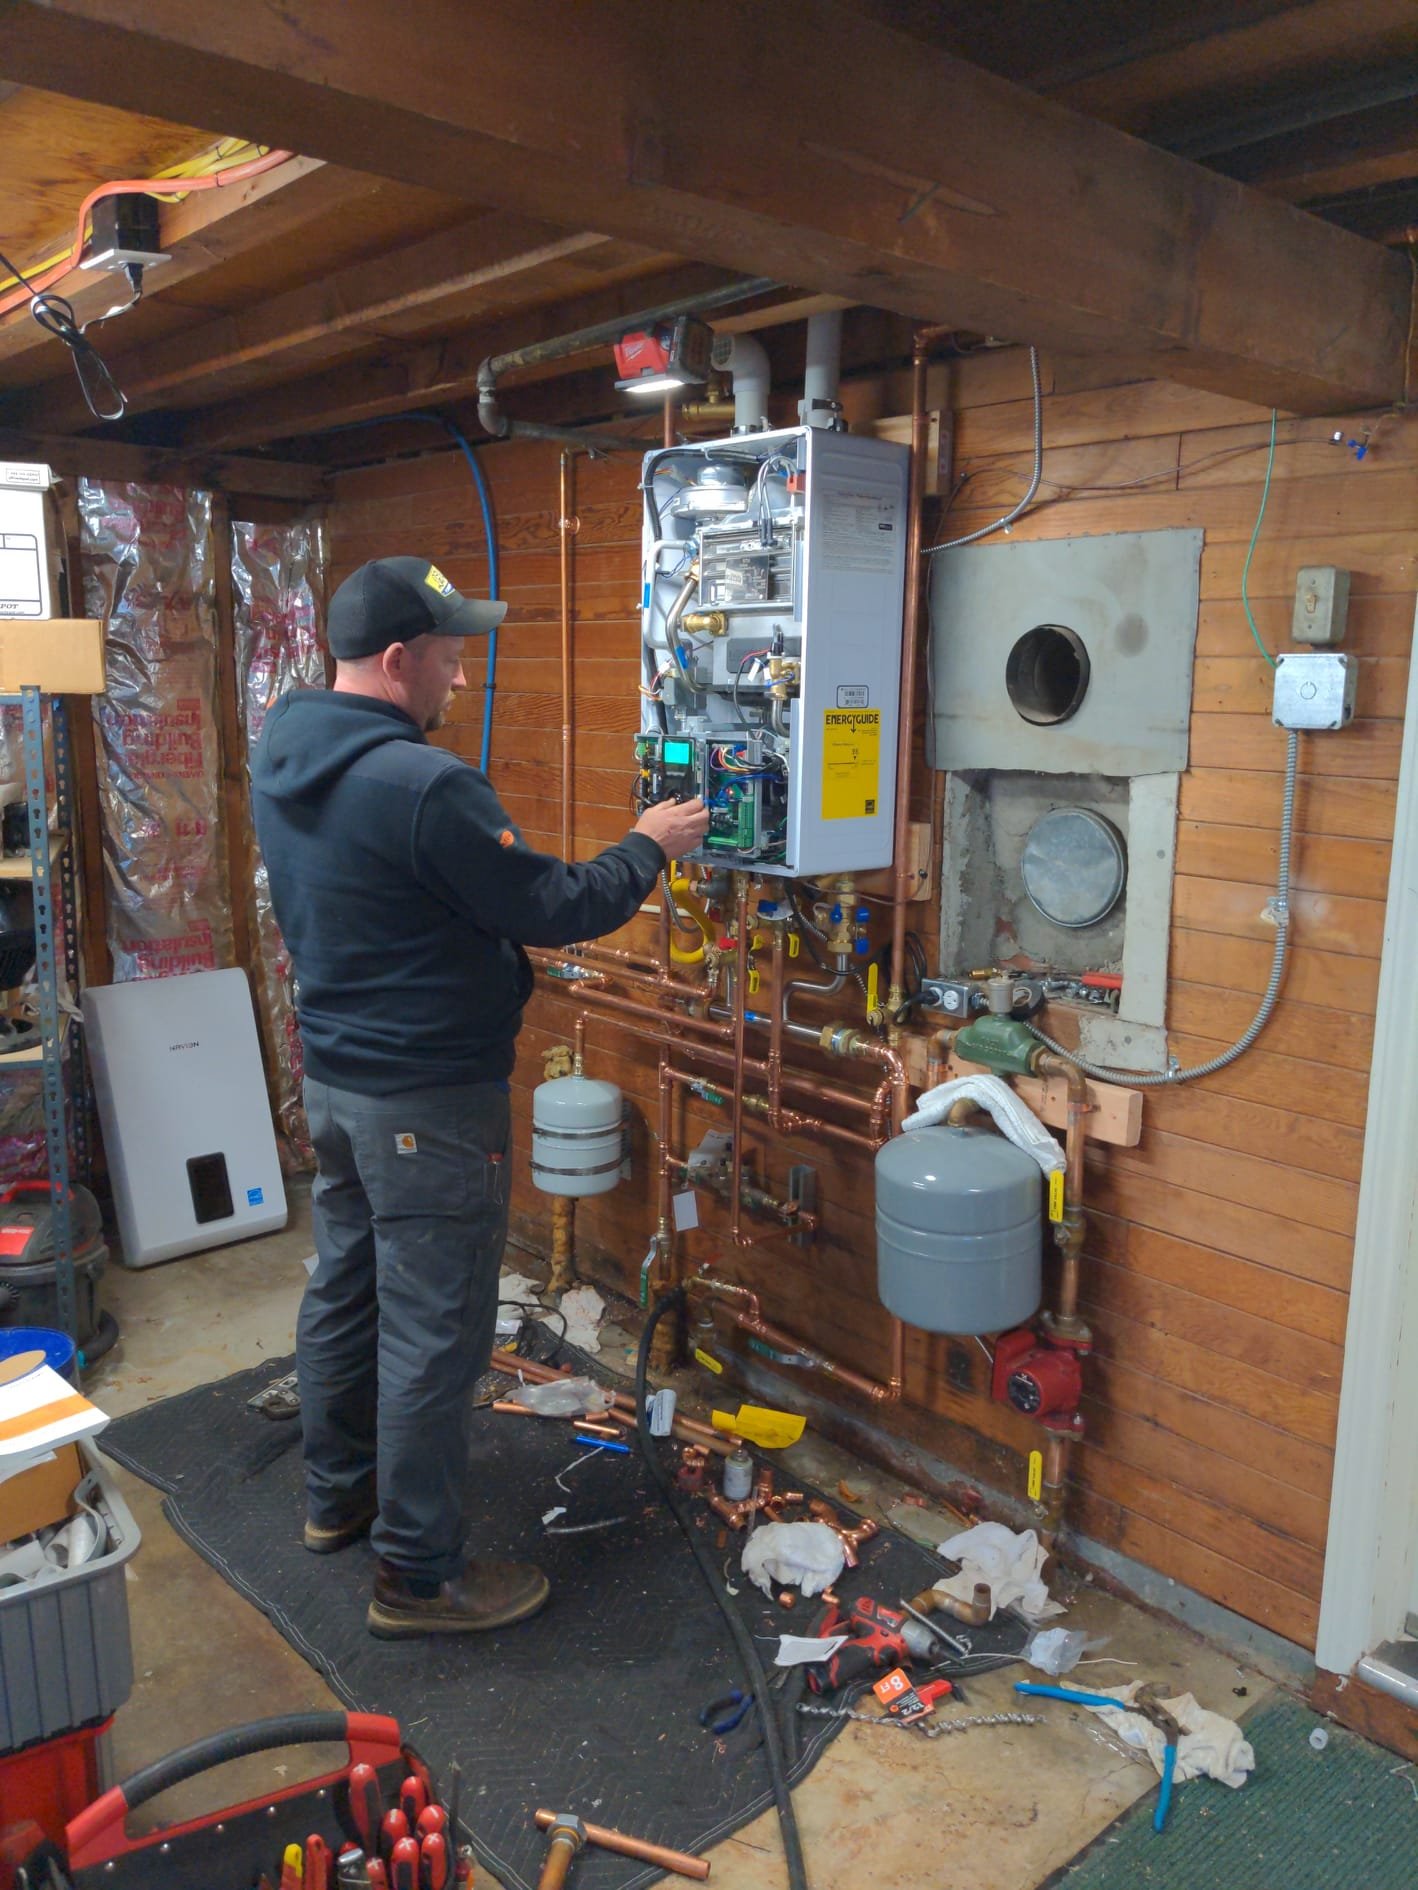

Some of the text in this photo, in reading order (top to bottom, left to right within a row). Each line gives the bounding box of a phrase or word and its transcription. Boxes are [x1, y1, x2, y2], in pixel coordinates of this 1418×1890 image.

[826, 714, 879, 725] ENERGYGUIDE
[122, 728, 202, 750] Building
[136, 952, 215, 972] Building
[880, 1676, 904, 1694] 8 FT
